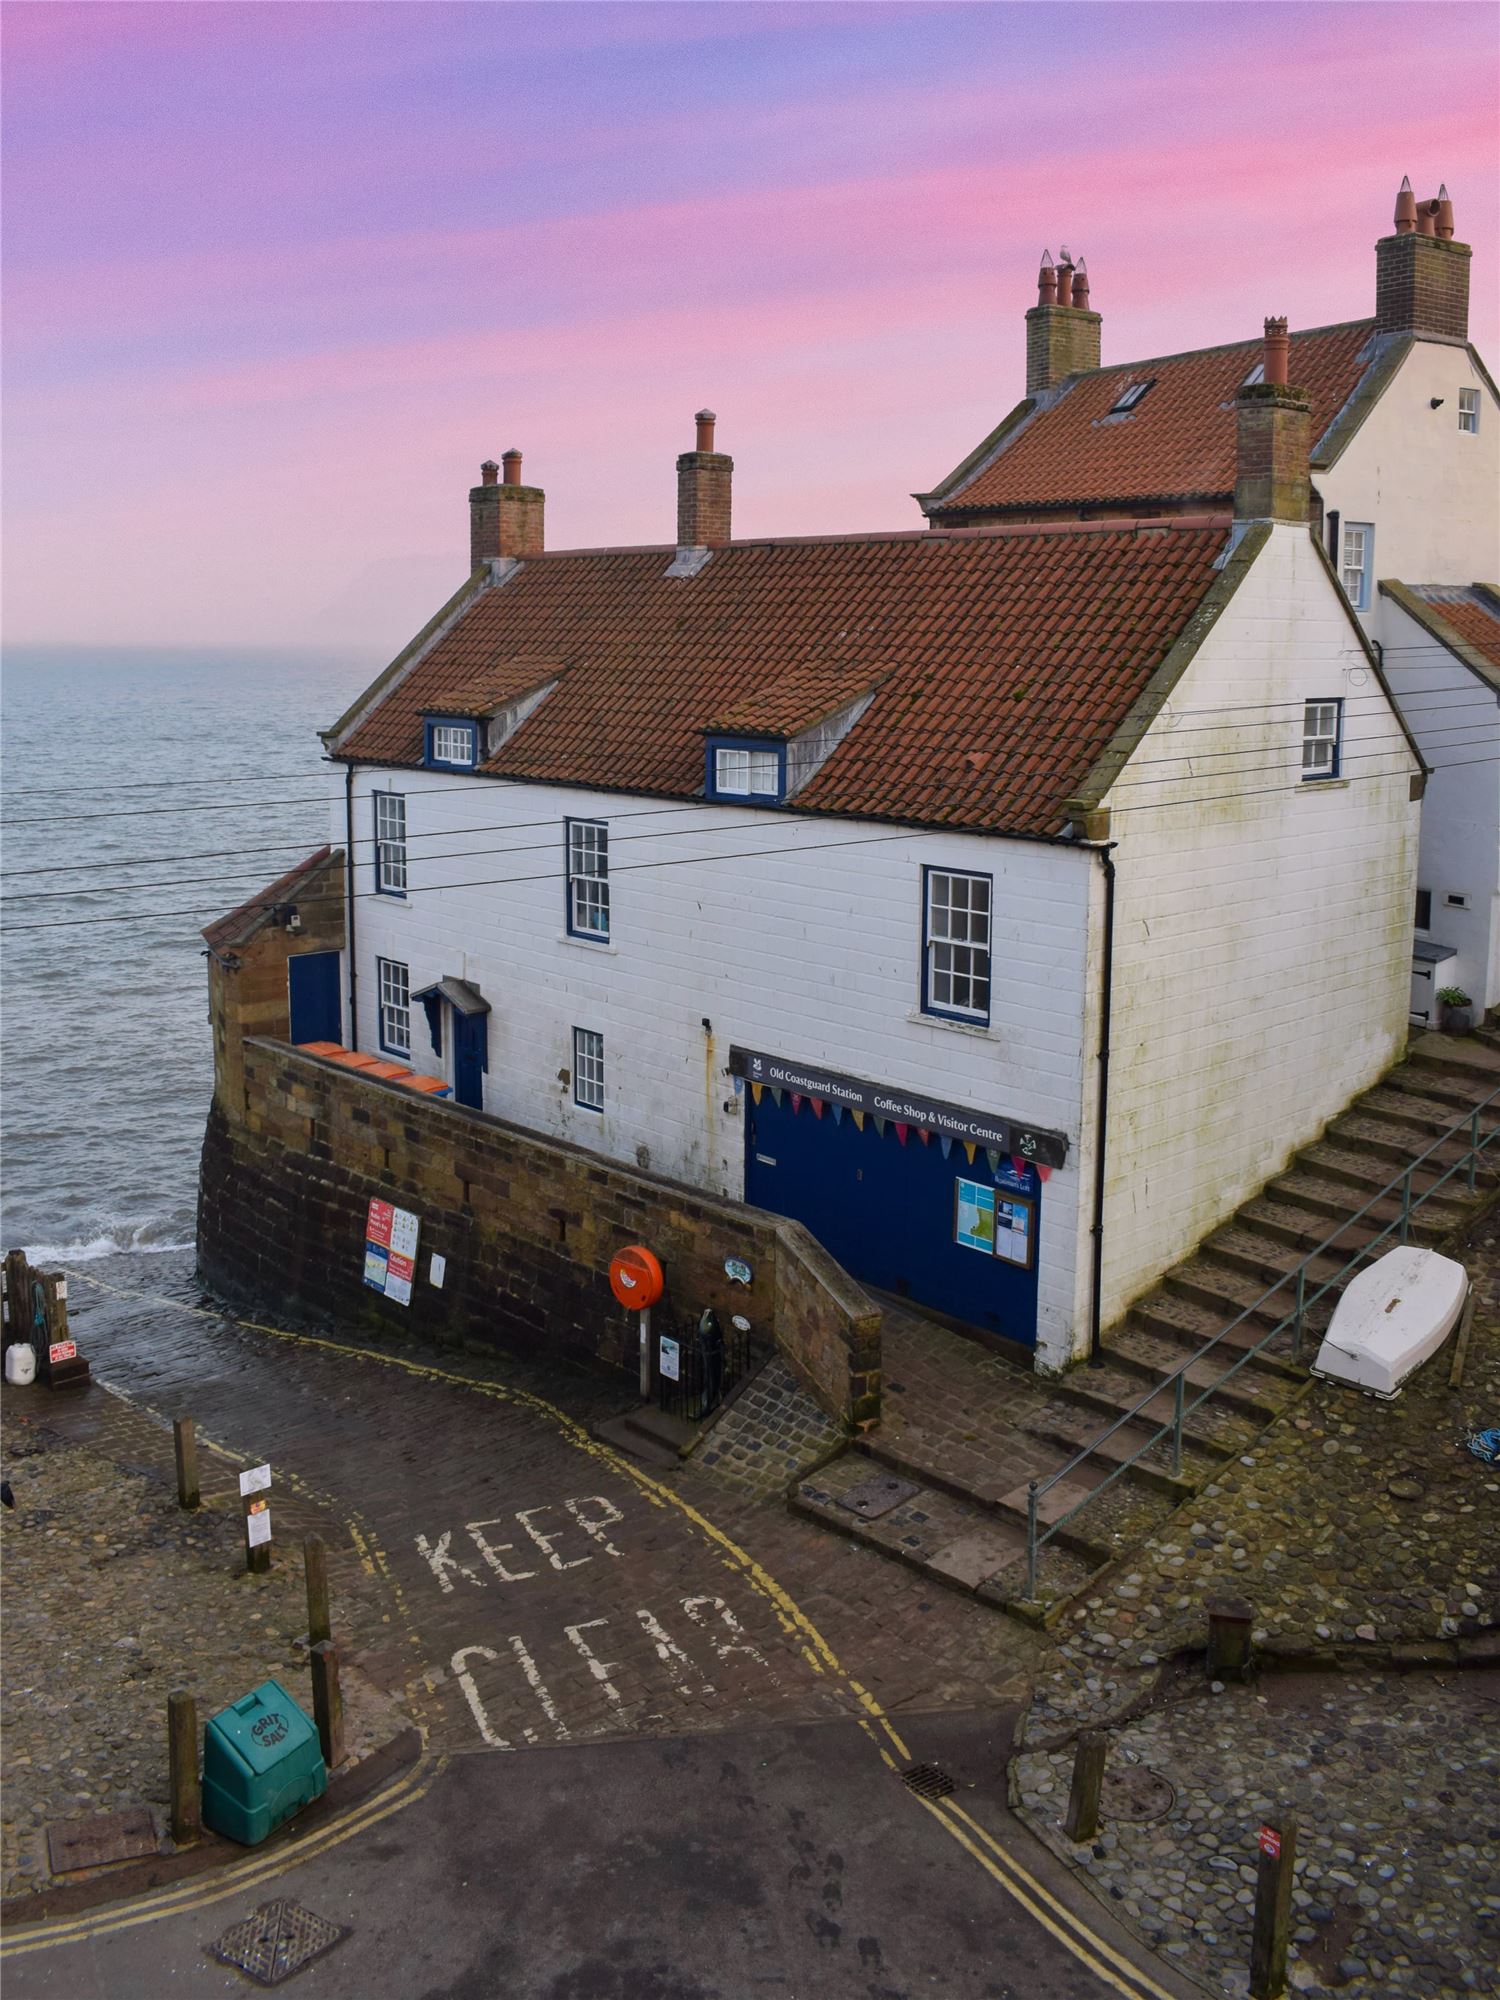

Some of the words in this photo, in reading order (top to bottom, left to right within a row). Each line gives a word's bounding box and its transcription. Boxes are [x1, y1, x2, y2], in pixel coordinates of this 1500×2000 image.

[770, 1067, 784, 1080] Old
[785, 1071, 831, 1093] Coastguard
[832, 1084, 863, 1102] Station
[874, 1096, 902, 1114] Coffee
[904, 1104, 927, 1122] Shop
[928, 1111, 936, 1123] &
[938, 1114, 968, 1132] Visitor
[969, 1123, 1003, 1142] Centre
[414, 1496, 625, 1593] KEEP
[252, 1713, 279, 1736] GRIT
[262, 1723, 288, 1747] SALT
